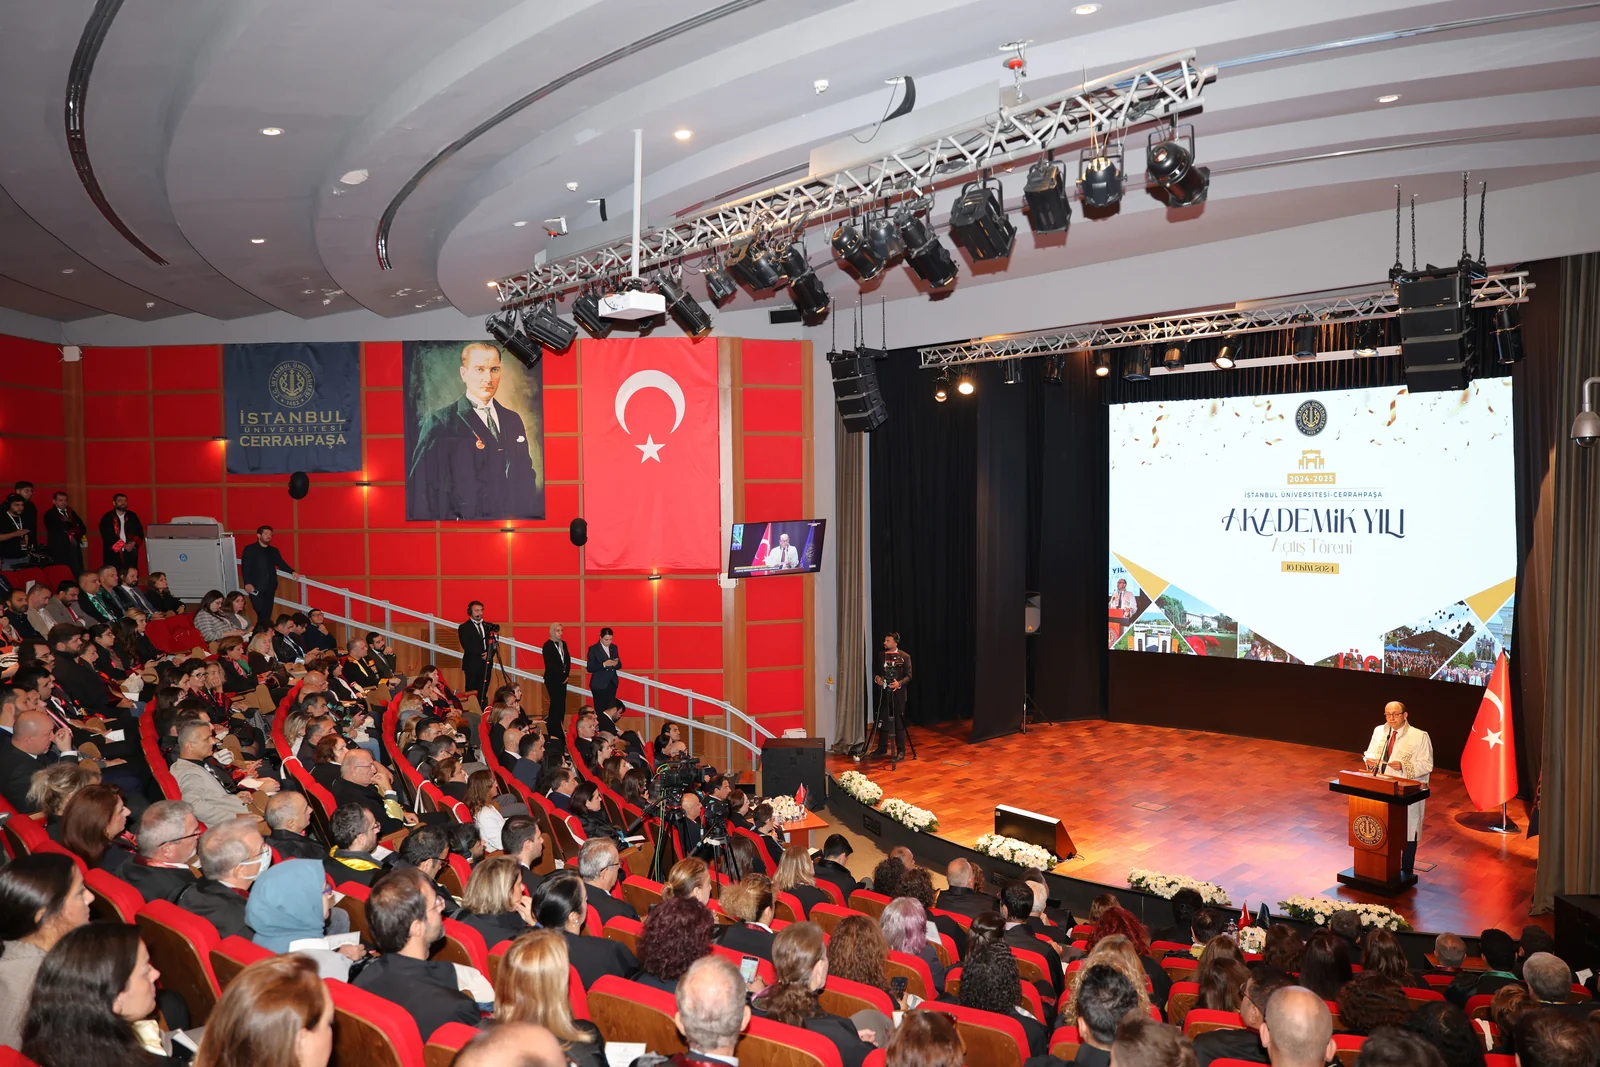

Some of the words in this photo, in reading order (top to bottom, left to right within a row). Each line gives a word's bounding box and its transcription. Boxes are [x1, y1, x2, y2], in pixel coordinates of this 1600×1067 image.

[240, 410, 346, 424] İSTANBUL
[244, 424, 342, 433] ÜNİVERSİTESİ
[240, 434, 347, 449] CERRAHPAŞA
[1289, 475, 1334, 483] 2024-2025
[1363, 508, 1406, 539] YILI
[1309, 538, 1353, 555] Töreni
